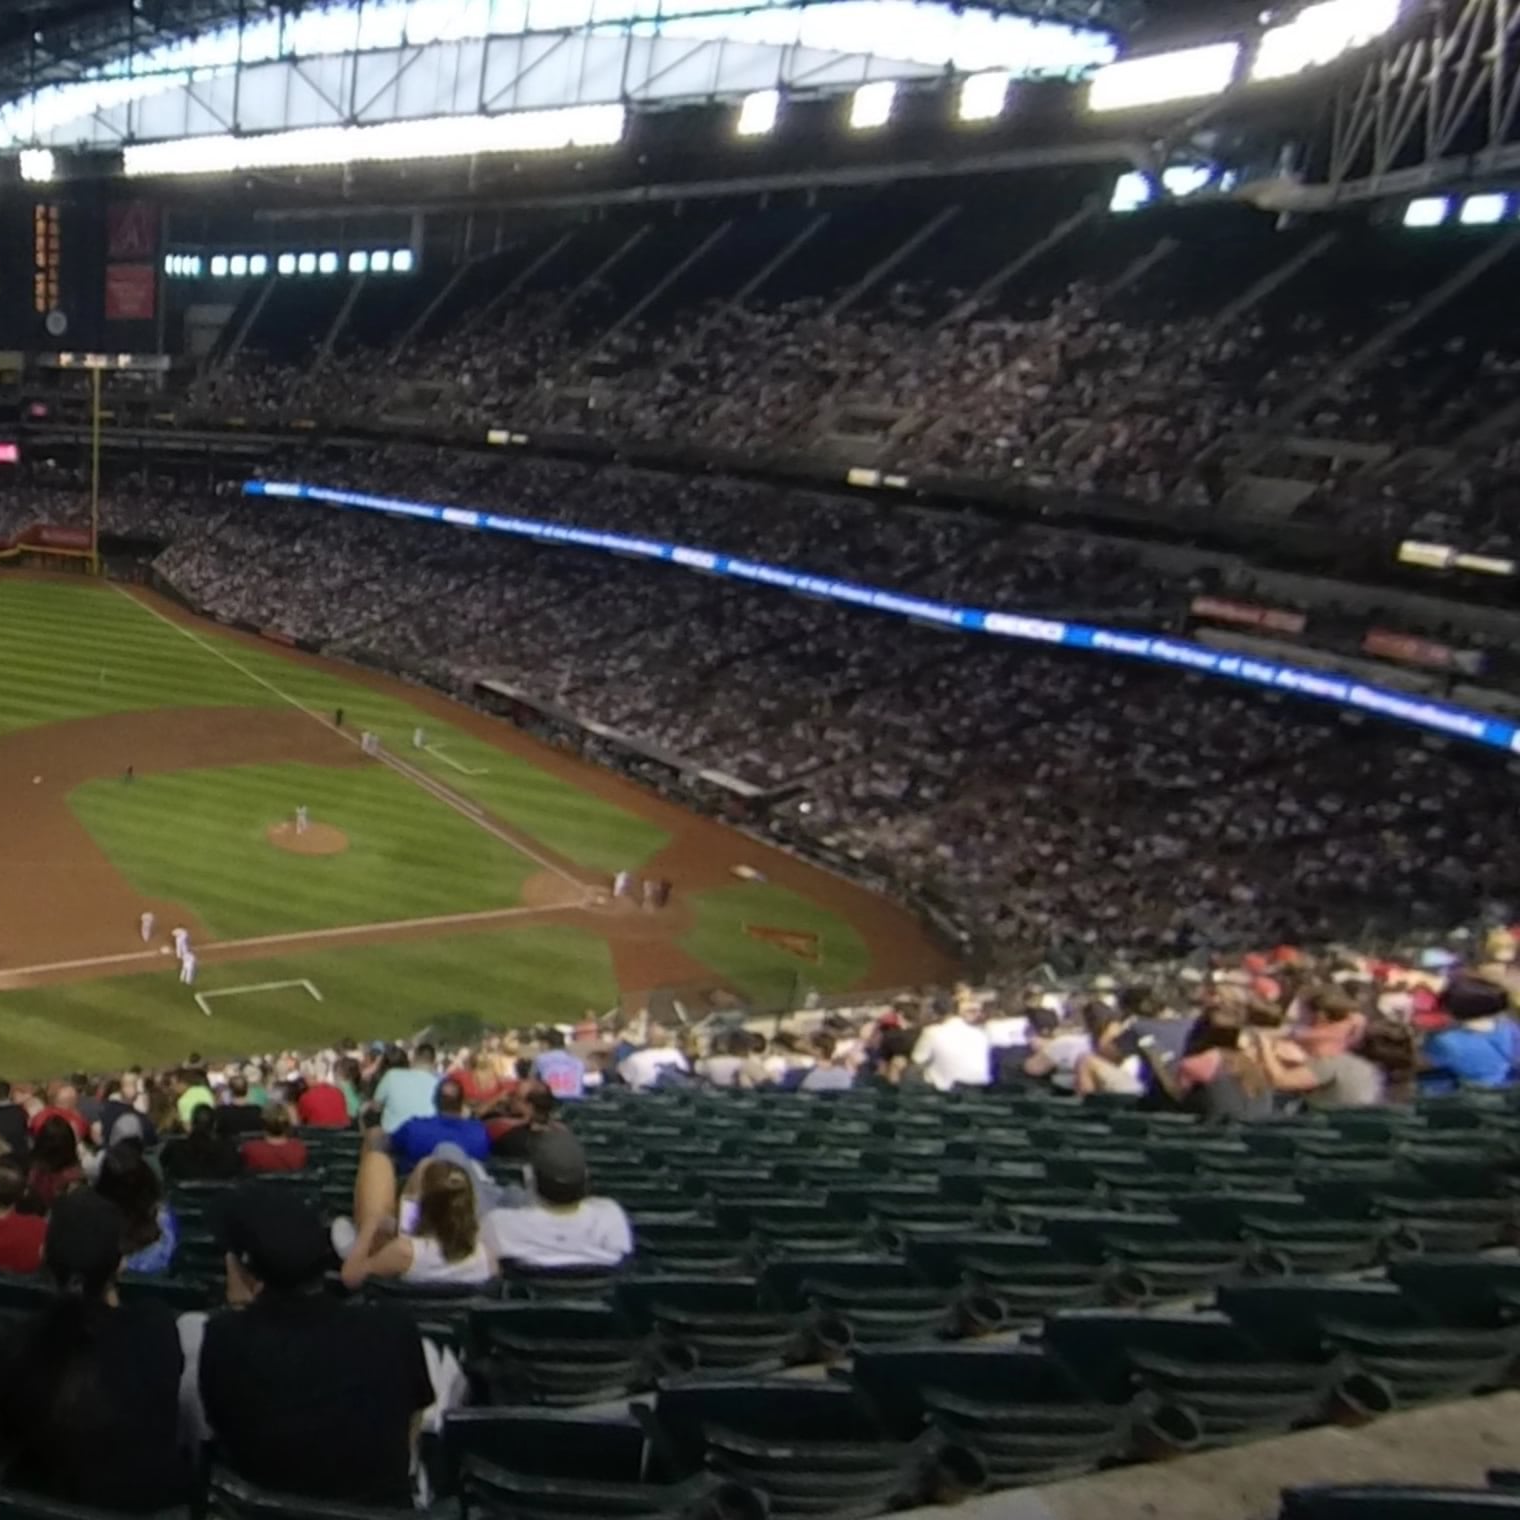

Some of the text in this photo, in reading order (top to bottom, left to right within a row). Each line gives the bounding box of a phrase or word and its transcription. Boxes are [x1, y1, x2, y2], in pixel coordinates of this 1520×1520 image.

[983, 611, 1066, 643] GEICO
[1092, 630, 1488, 737] Proud Partner of the Arizona Diamondbacks
